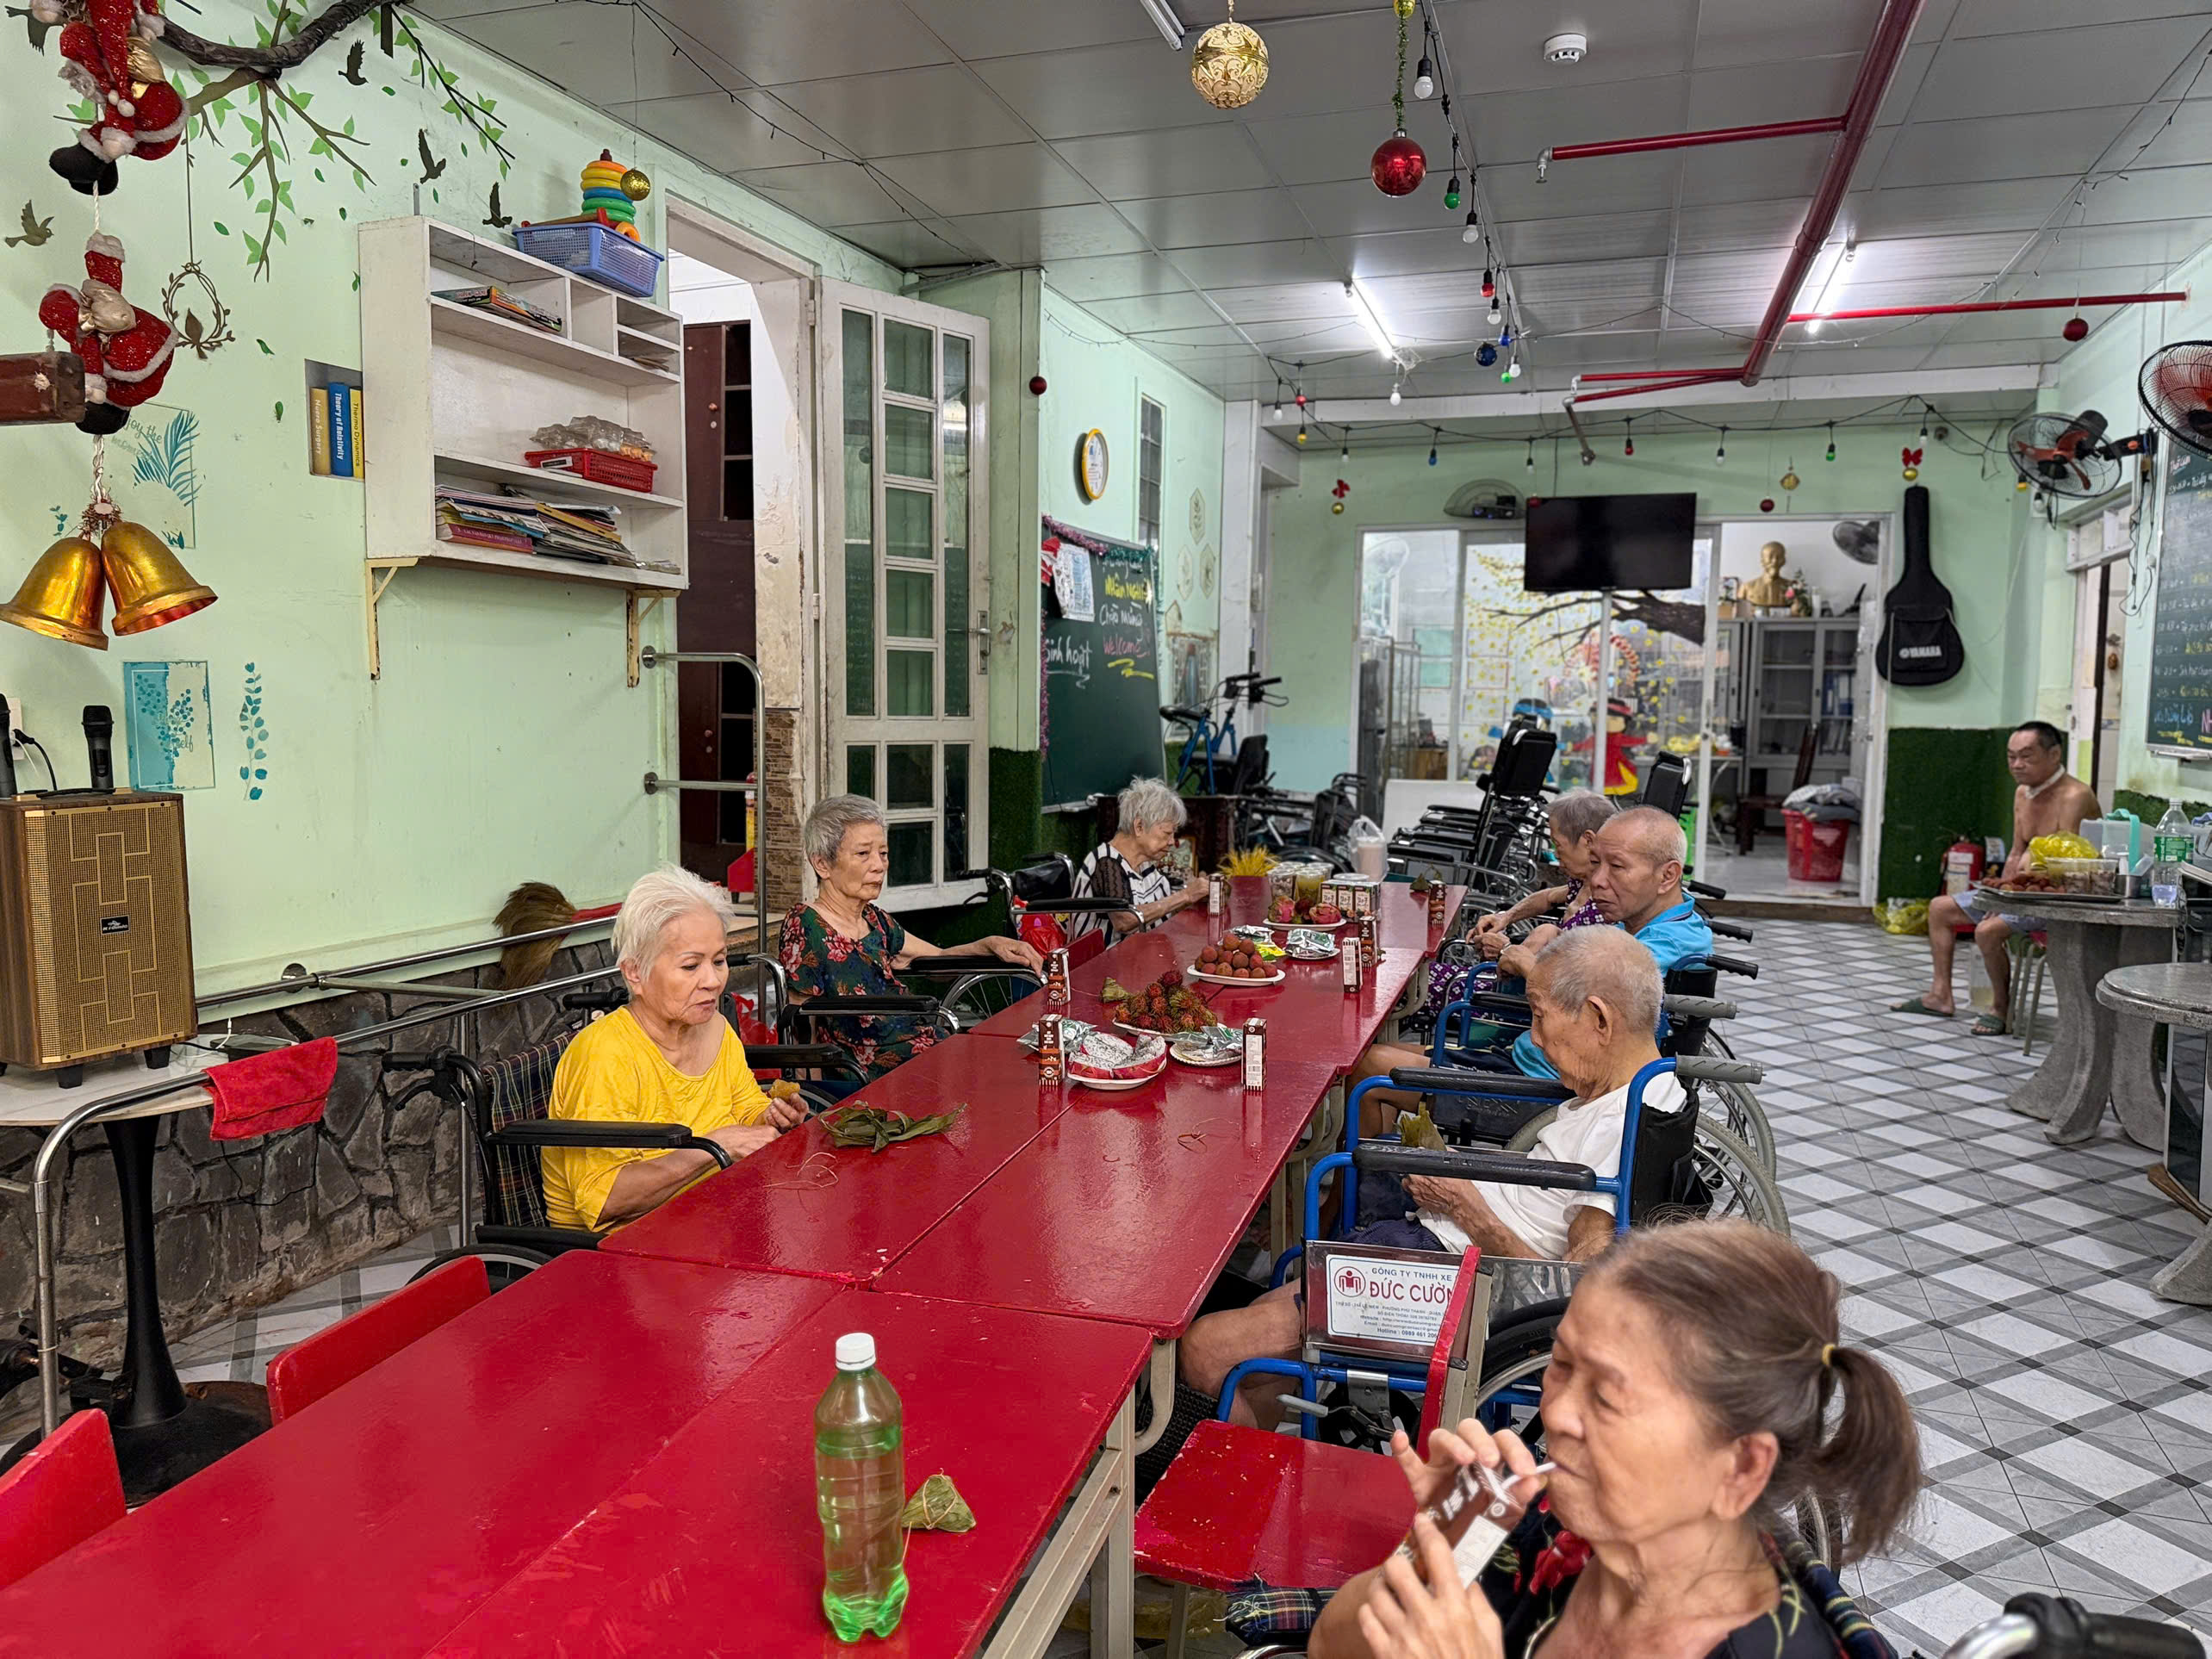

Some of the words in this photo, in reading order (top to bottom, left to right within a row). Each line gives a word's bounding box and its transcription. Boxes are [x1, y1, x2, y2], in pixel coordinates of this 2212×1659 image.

[123, 415, 143, 439] joy
[146, 425, 163, 444] the
[314, 425, 323, 455] Surgery
[336, 426, 345, 460] Relativity
[1908, 645, 1942, 658] YAMAHA
[1414, 1271, 1438, 1280] TNHH
[1370, 1277, 1405, 1301] ĐỨC
